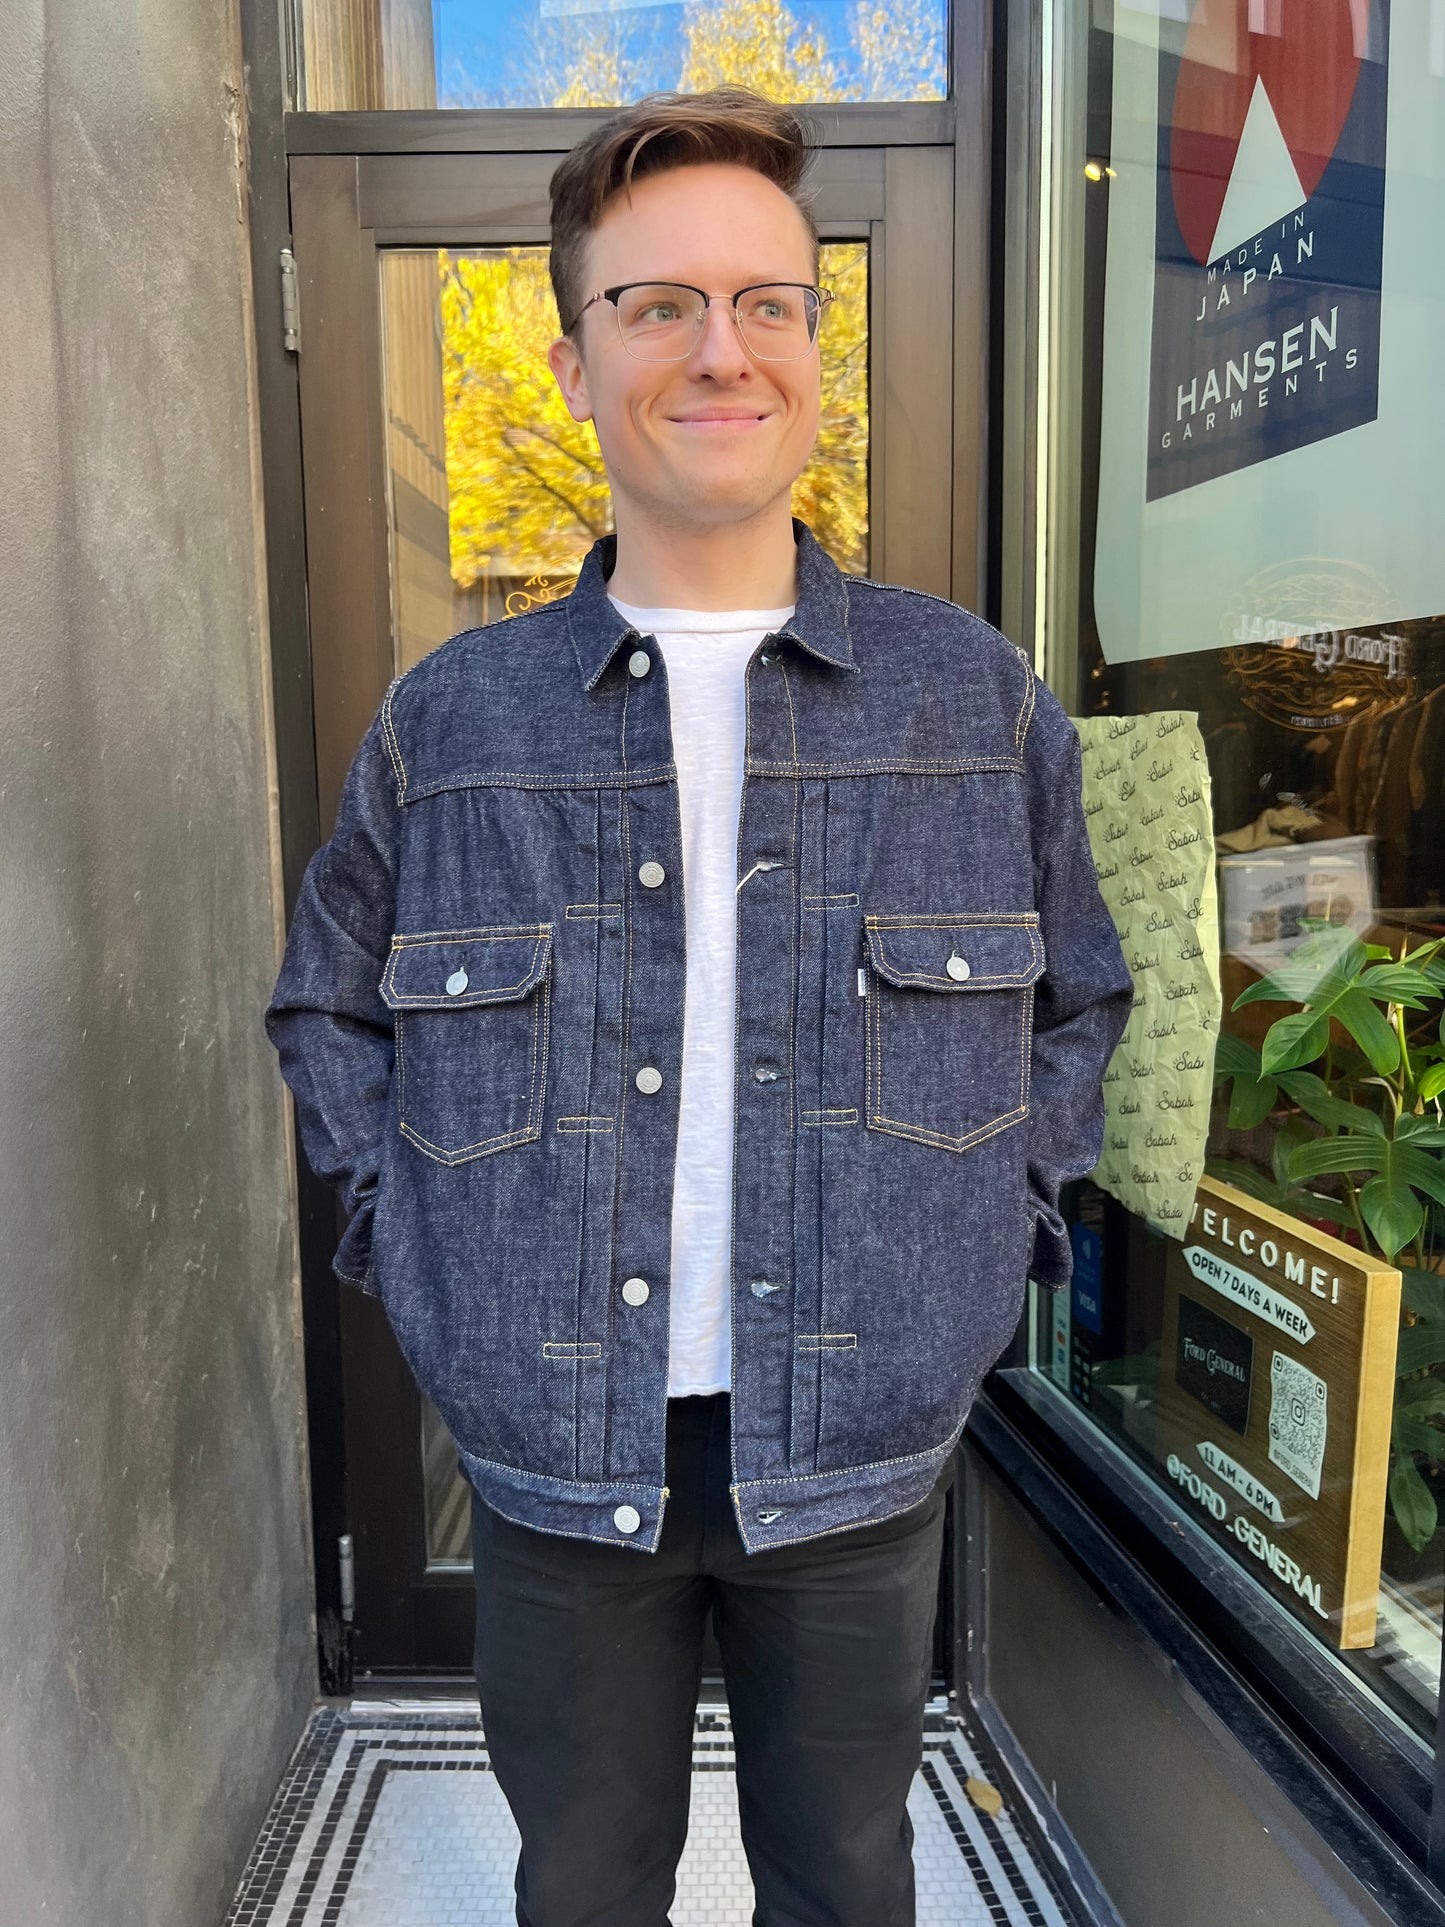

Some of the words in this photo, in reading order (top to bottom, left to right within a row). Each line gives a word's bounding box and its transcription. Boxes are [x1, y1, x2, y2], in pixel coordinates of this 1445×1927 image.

[1196, 231, 1314, 321] JAPAN
[1207, 238, 1262, 285] MADE
[1282, 212, 1304, 238] IN
[1161, 348, 1358, 449] GARMENTS
[1175, 305, 1339, 422] HANSEN
[1192, 1252, 1222, 1280] OPEN
[1222, 1271, 1231, 1285] 7
[1231, 1276, 1261, 1306] DAYS
[1263, 1298, 1271, 1314] A
[1275, 1303, 1308, 1338] WEEK
[1204, 1447, 1215, 1467] 11
[1218, 1459, 1236, 1483] AM
[1246, 1482, 1253, 1498] 6
[1256, 1489, 1274, 1516] PM
